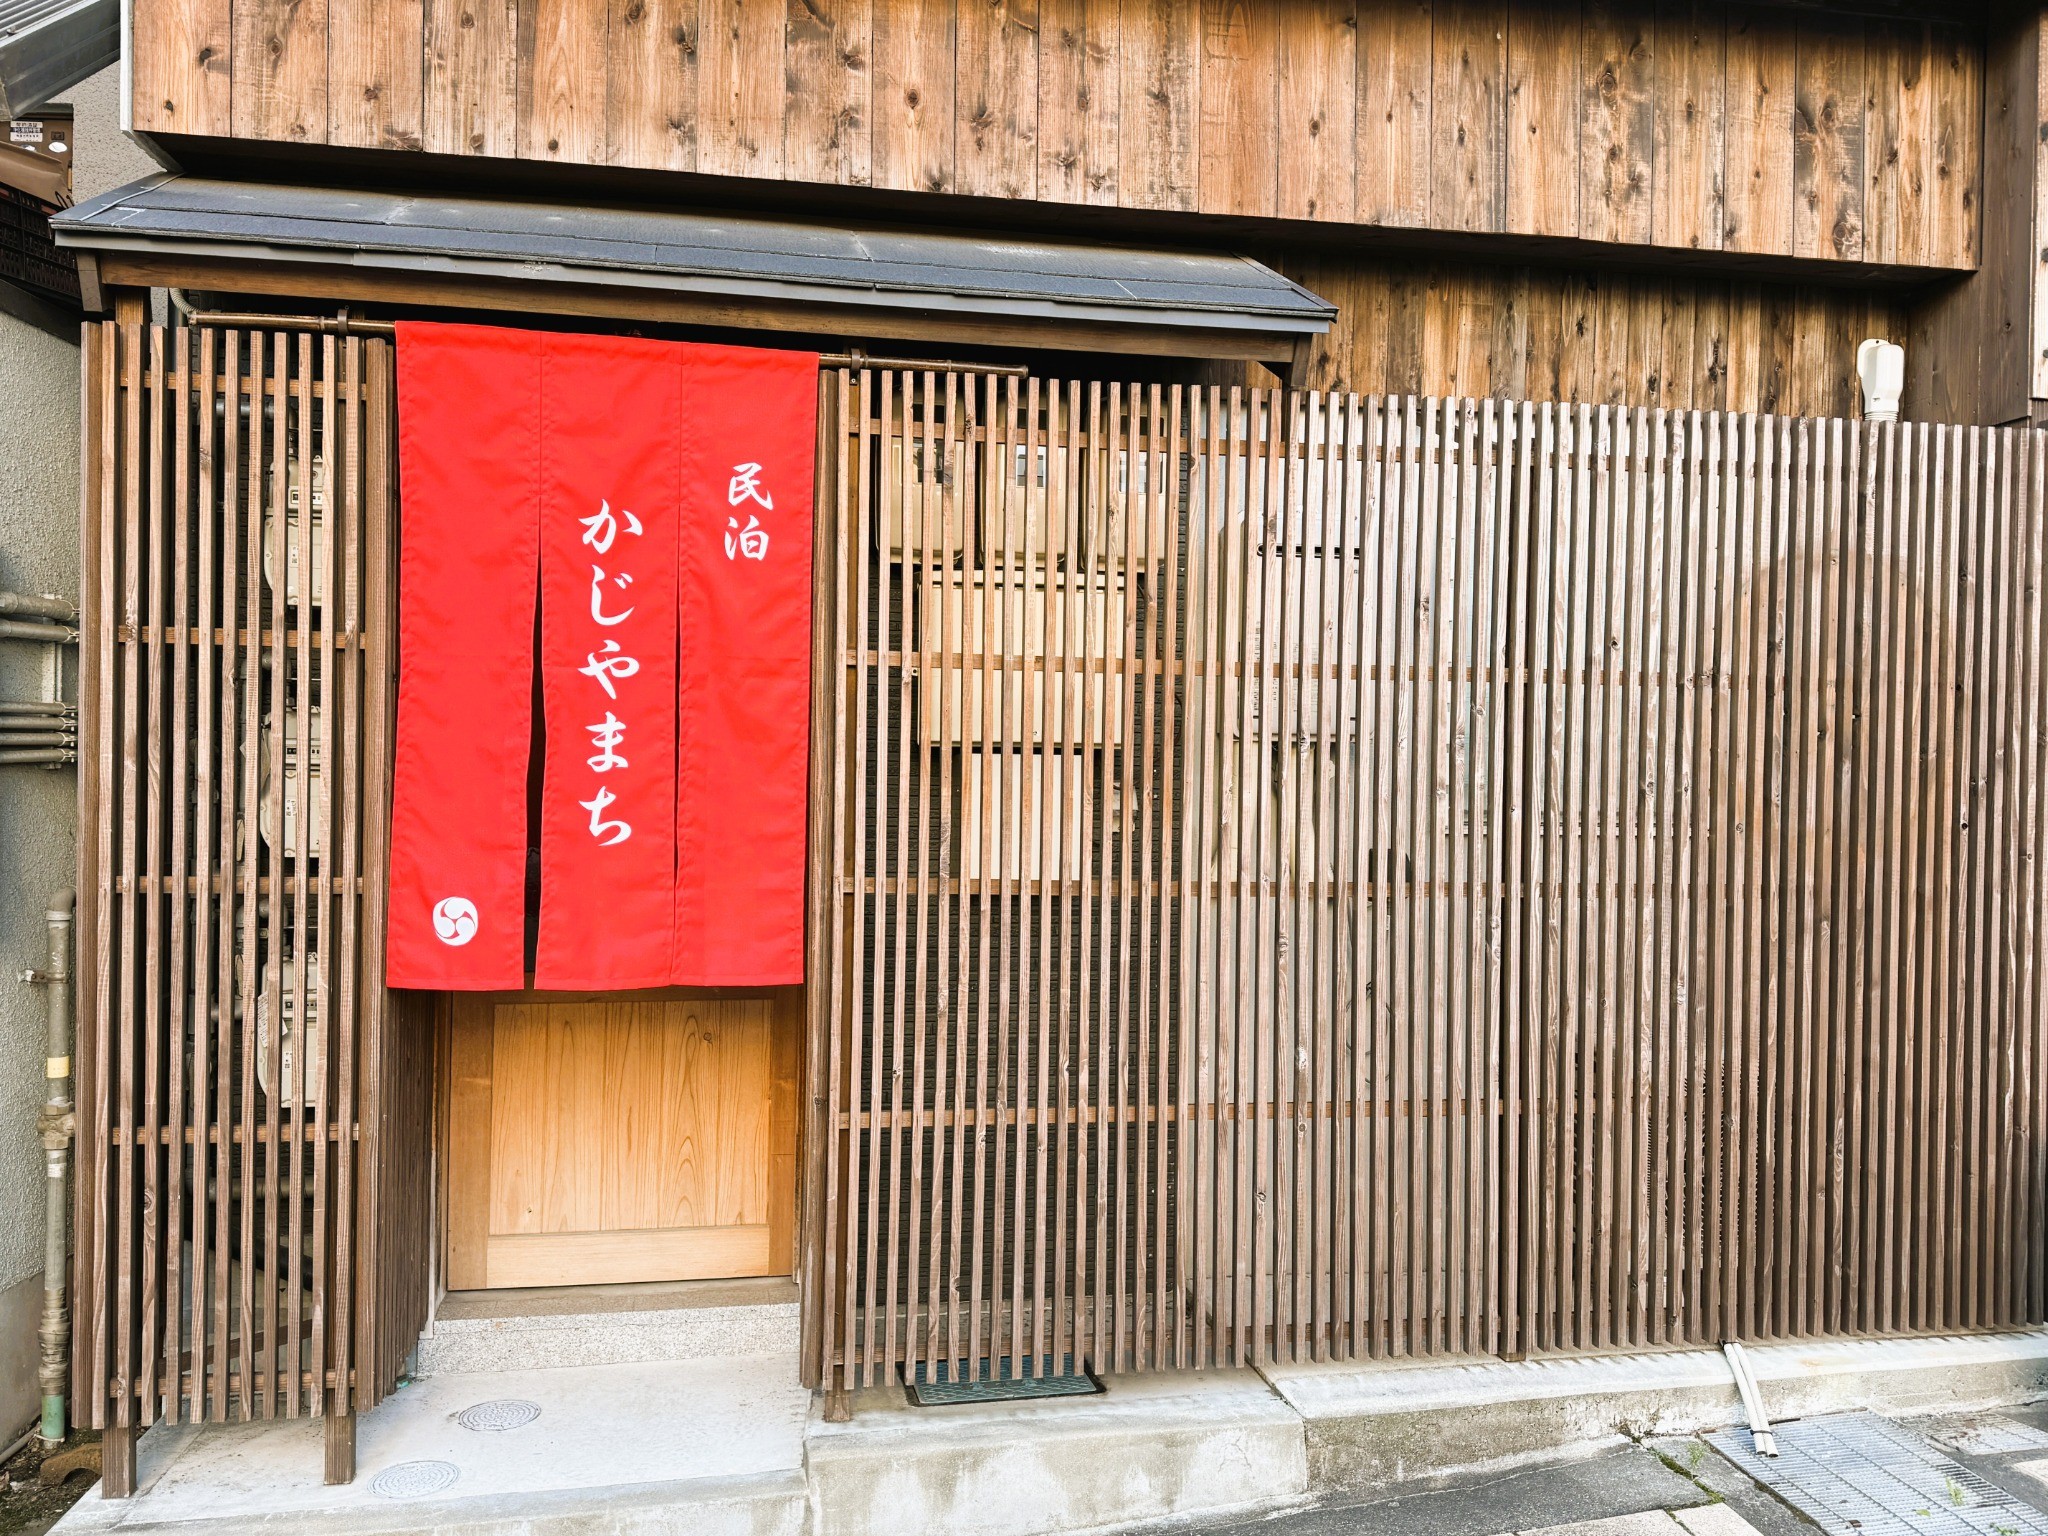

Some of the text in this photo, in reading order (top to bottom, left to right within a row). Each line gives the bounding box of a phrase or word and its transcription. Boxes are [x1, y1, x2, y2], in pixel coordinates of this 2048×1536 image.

[724, 462, 774, 561] 民泊
[577, 498, 643, 846] かじやまち
